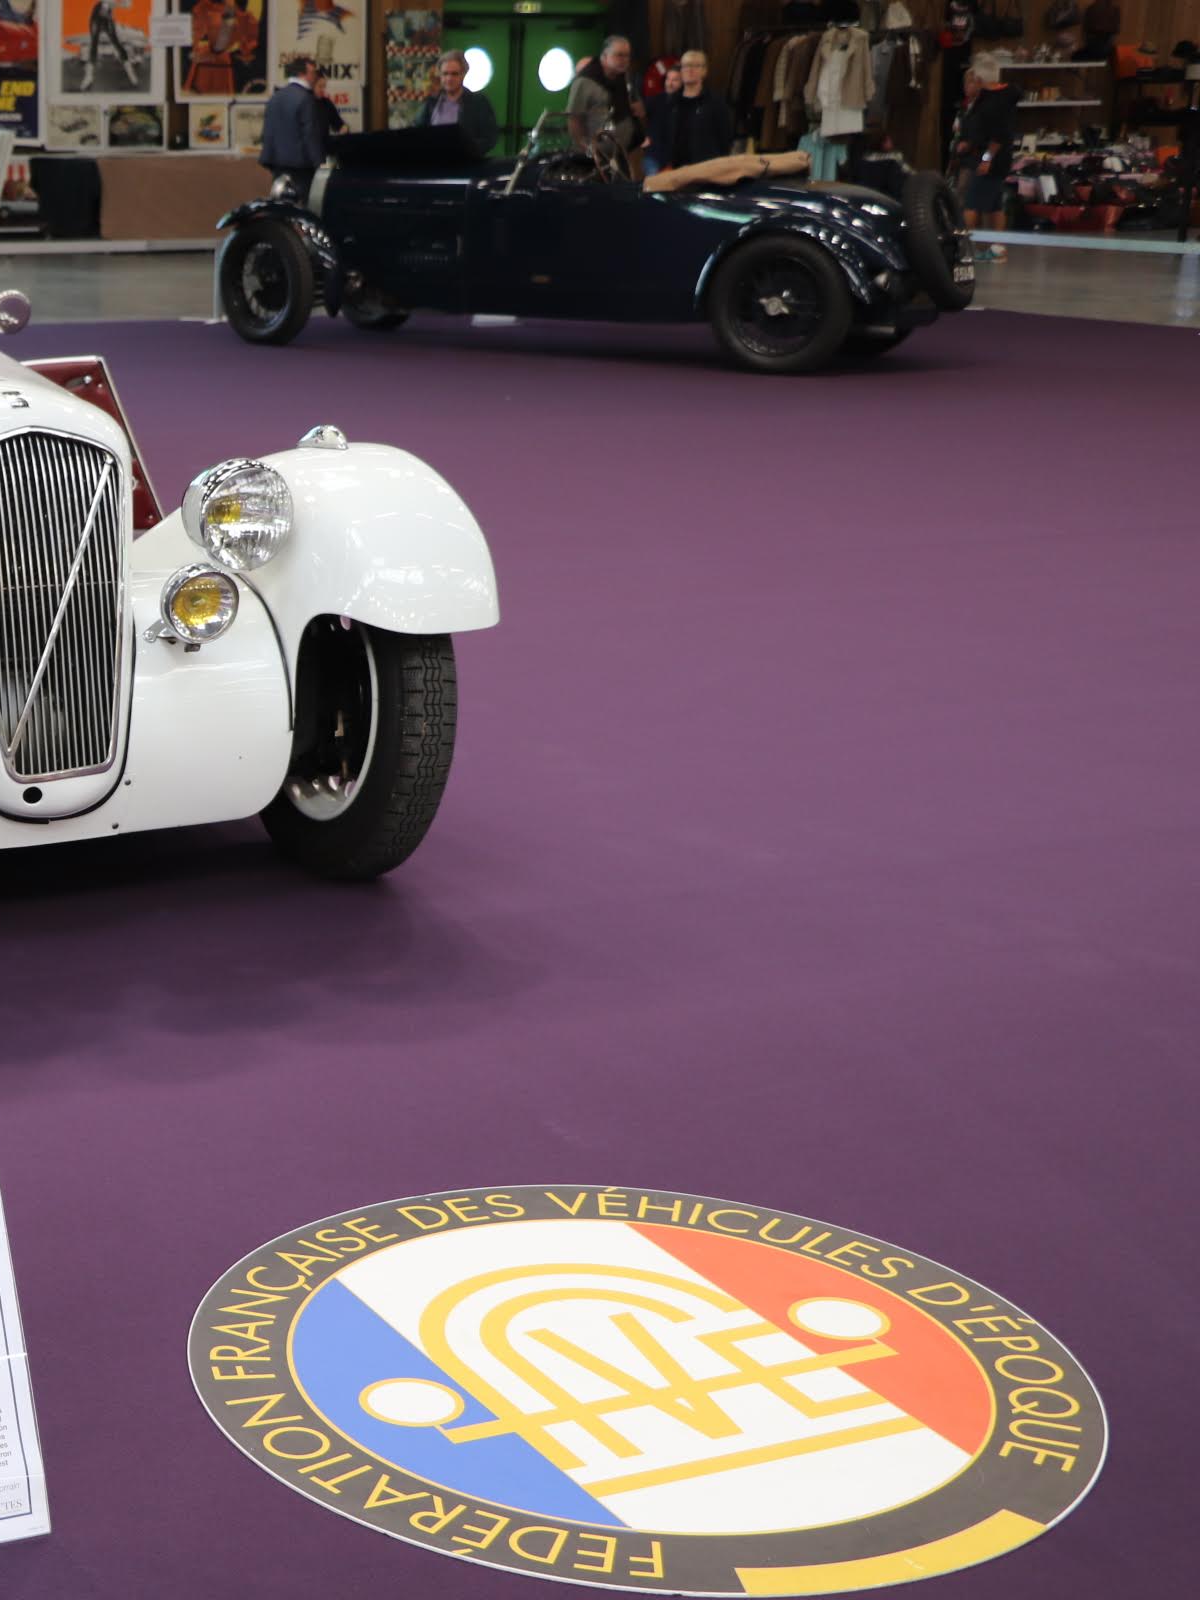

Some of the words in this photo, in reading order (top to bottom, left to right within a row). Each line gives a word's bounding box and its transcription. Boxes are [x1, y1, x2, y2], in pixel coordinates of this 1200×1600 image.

[0, 81, 35, 96] END
[397, 1193, 526, 1230] DES
[545, 1187, 914, 1279] VÉHICULES
[209, 1217, 399, 1381] FRANÇAISE
[907, 1281, 1082, 1473] D'ÉPOQUE
[225, 1393, 664, 1578] FÉDÉRATION
